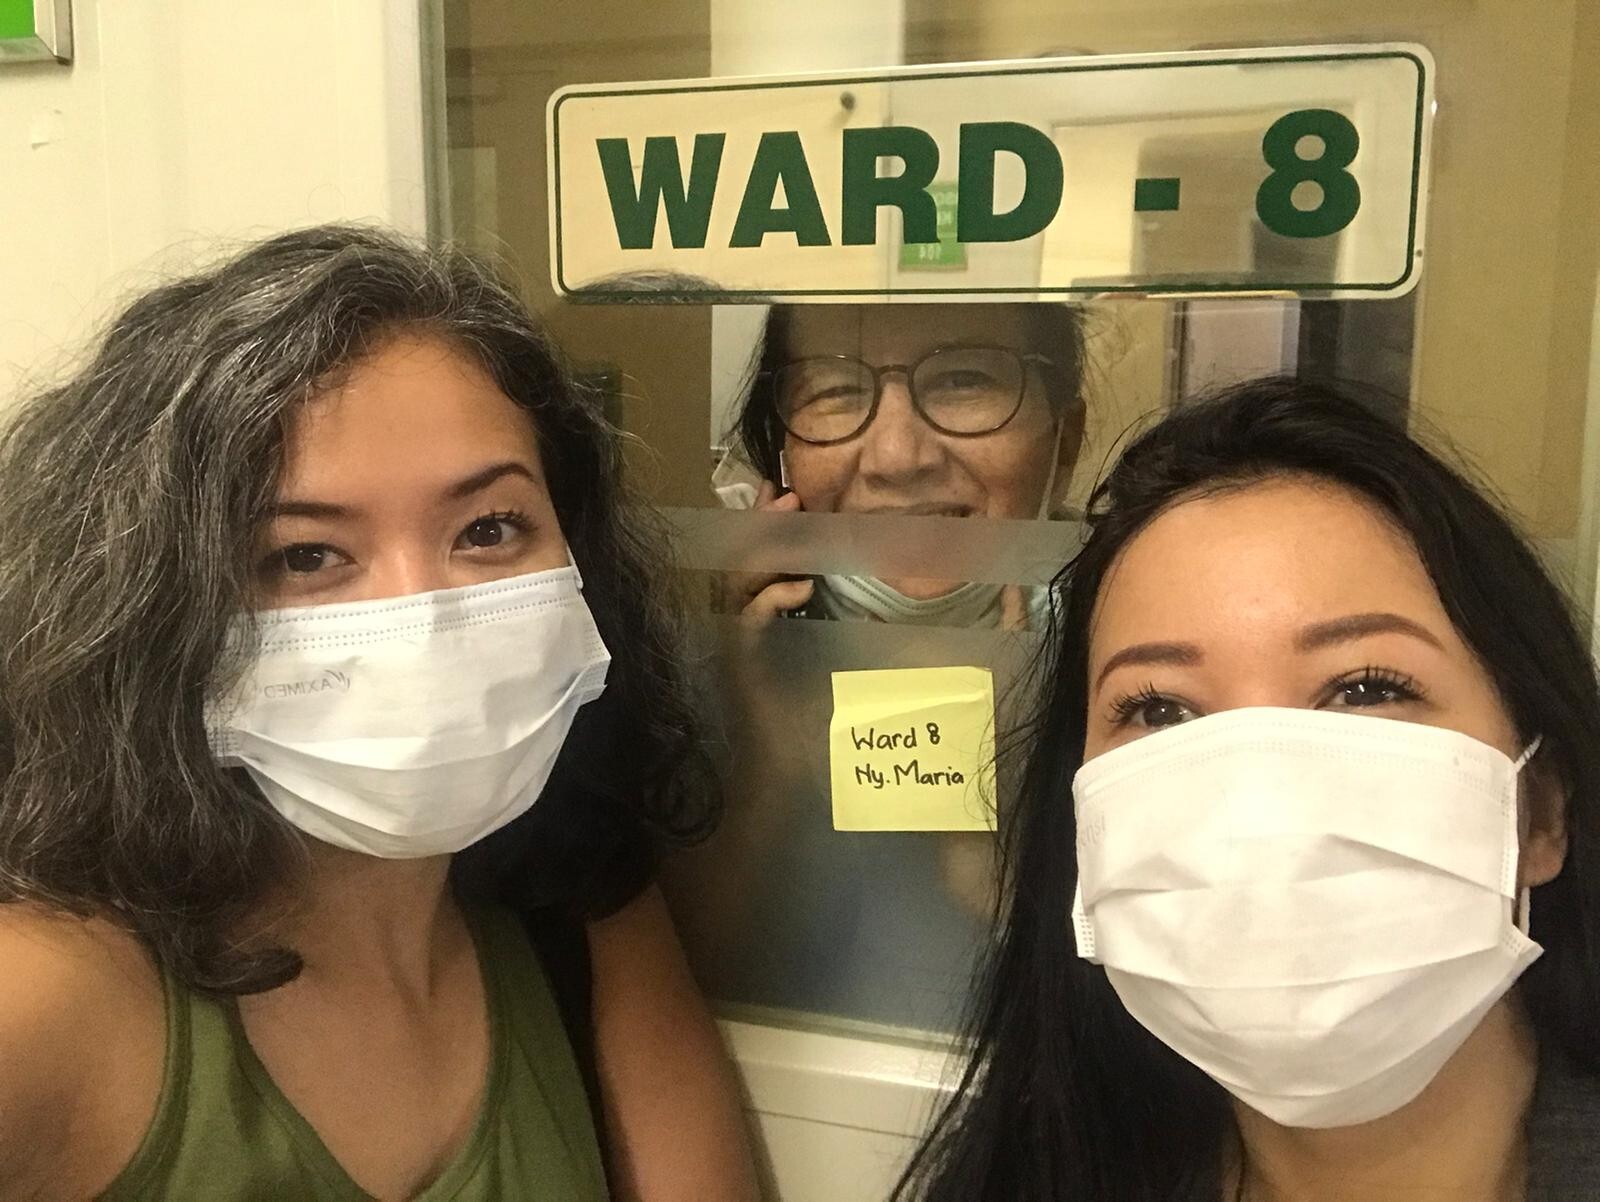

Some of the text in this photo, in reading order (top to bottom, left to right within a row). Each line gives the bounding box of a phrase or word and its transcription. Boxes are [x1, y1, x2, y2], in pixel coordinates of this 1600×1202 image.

[596, 122, 1064, 250] WARD
[1134, 177, 1181, 212] -
[1256, 108, 1361, 239] 8
[851, 722, 941, 750] Ward 8
[893, 759, 964, 786] Maria
